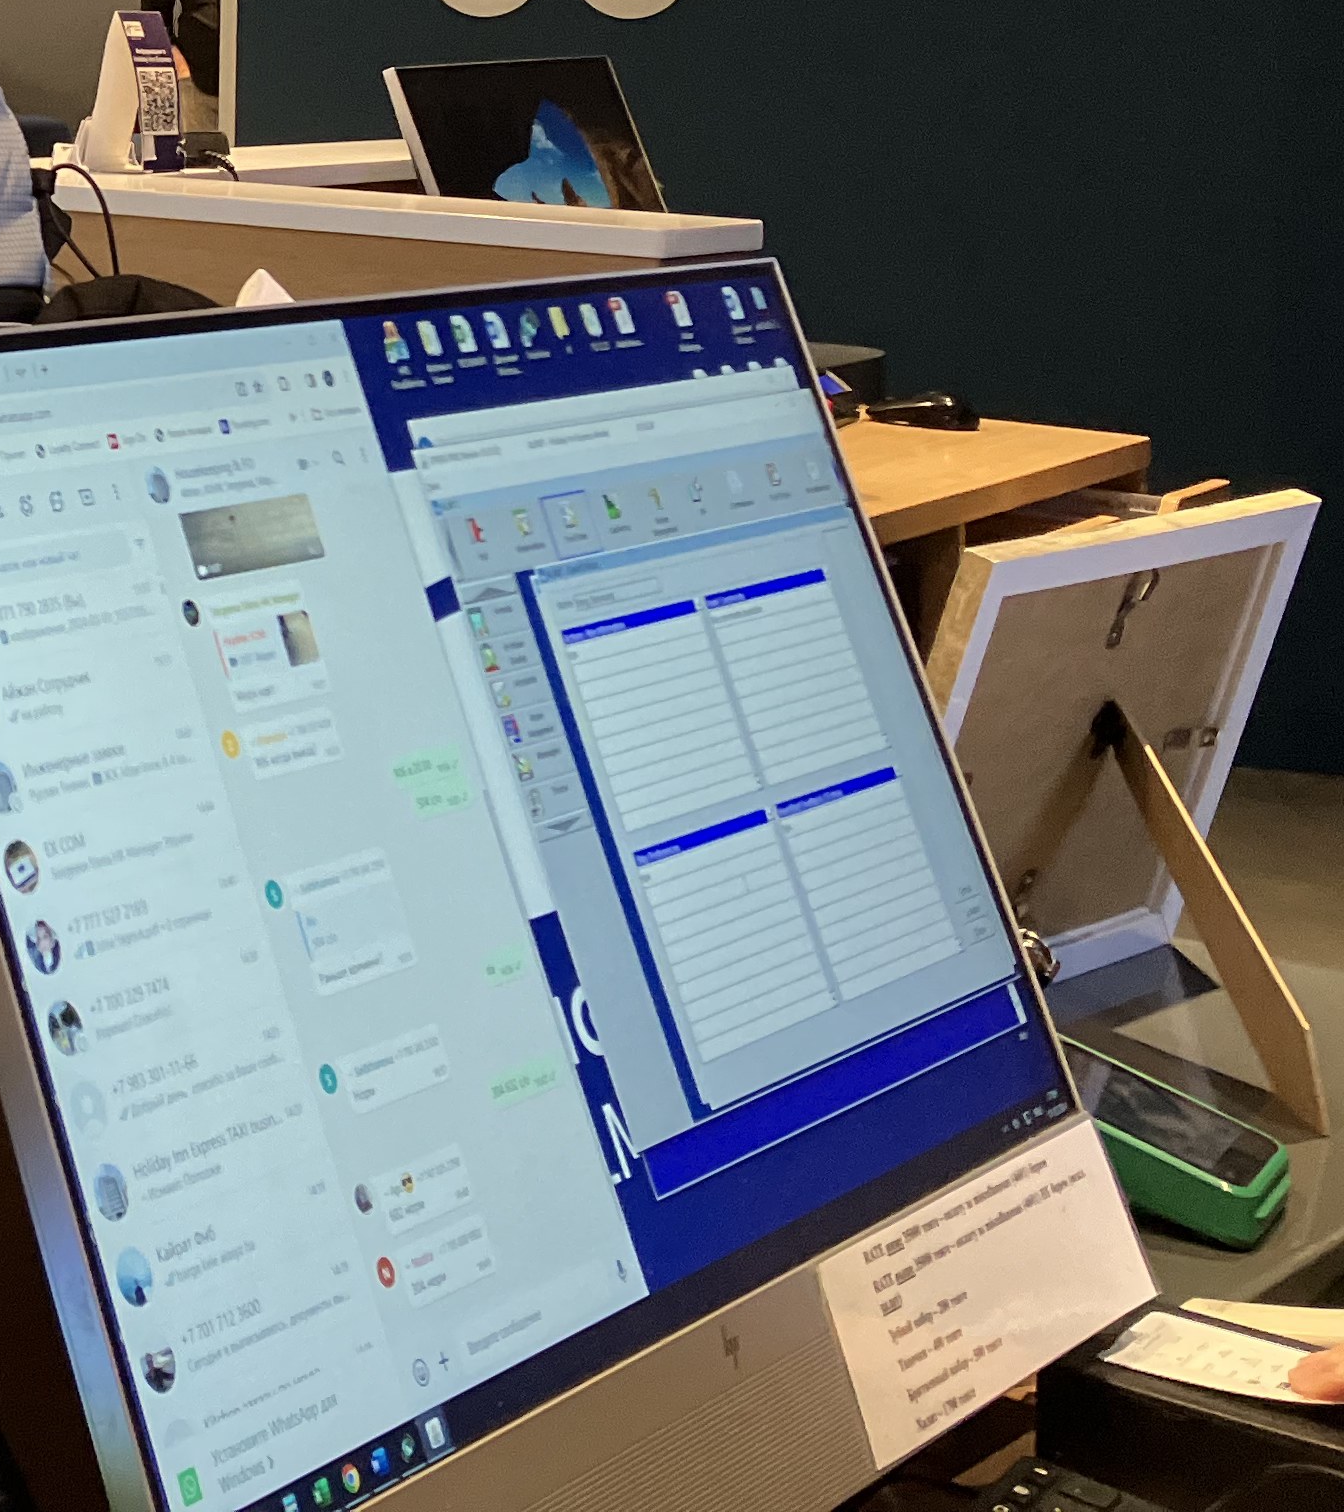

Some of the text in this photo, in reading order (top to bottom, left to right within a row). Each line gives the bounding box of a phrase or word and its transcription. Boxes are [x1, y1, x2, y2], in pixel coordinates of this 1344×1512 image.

[132, 1150, 173, 1183] Holiday
[171, 1144, 191, 1164] Inn
[189, 1130, 229, 1161] Express
[196, 1318, 216, 1340] 701
[216, 1309, 238, 1331] 712
[235, 1296, 263, 1322] 3600
